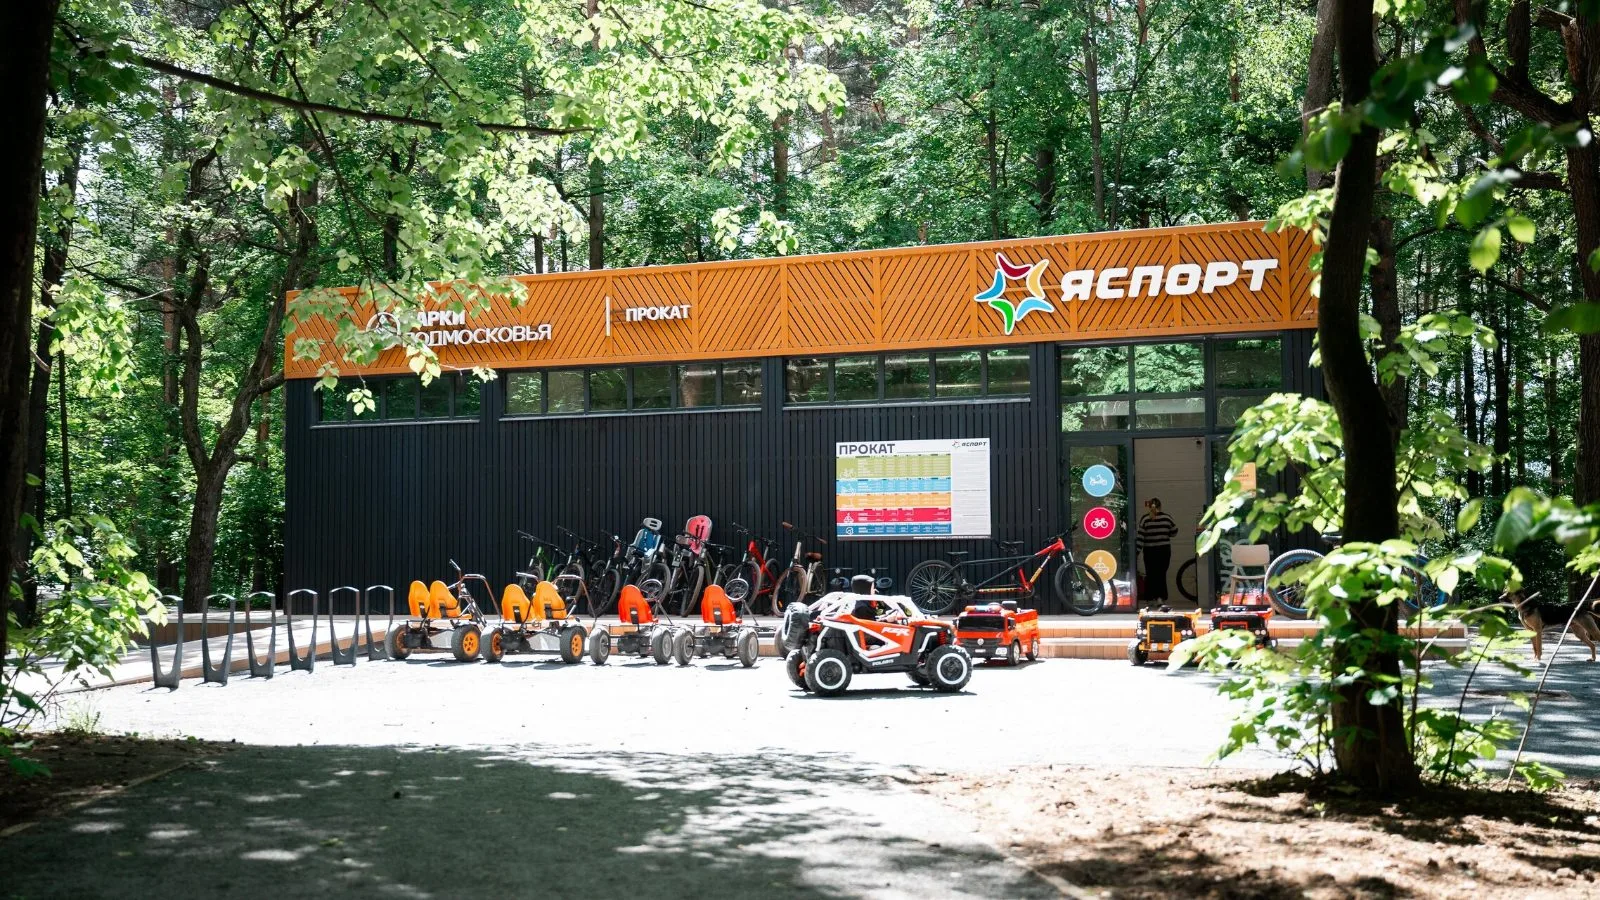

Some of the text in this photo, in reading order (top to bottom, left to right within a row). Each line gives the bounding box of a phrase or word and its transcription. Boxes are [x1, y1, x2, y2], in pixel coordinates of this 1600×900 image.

[1060, 258, 1279, 302] ЯСПОРТ
[409, 309, 466, 327] АРКИ
[625, 304, 692, 322] ПРОКАТ
[839, 444, 895, 454] ПРОКАТ
